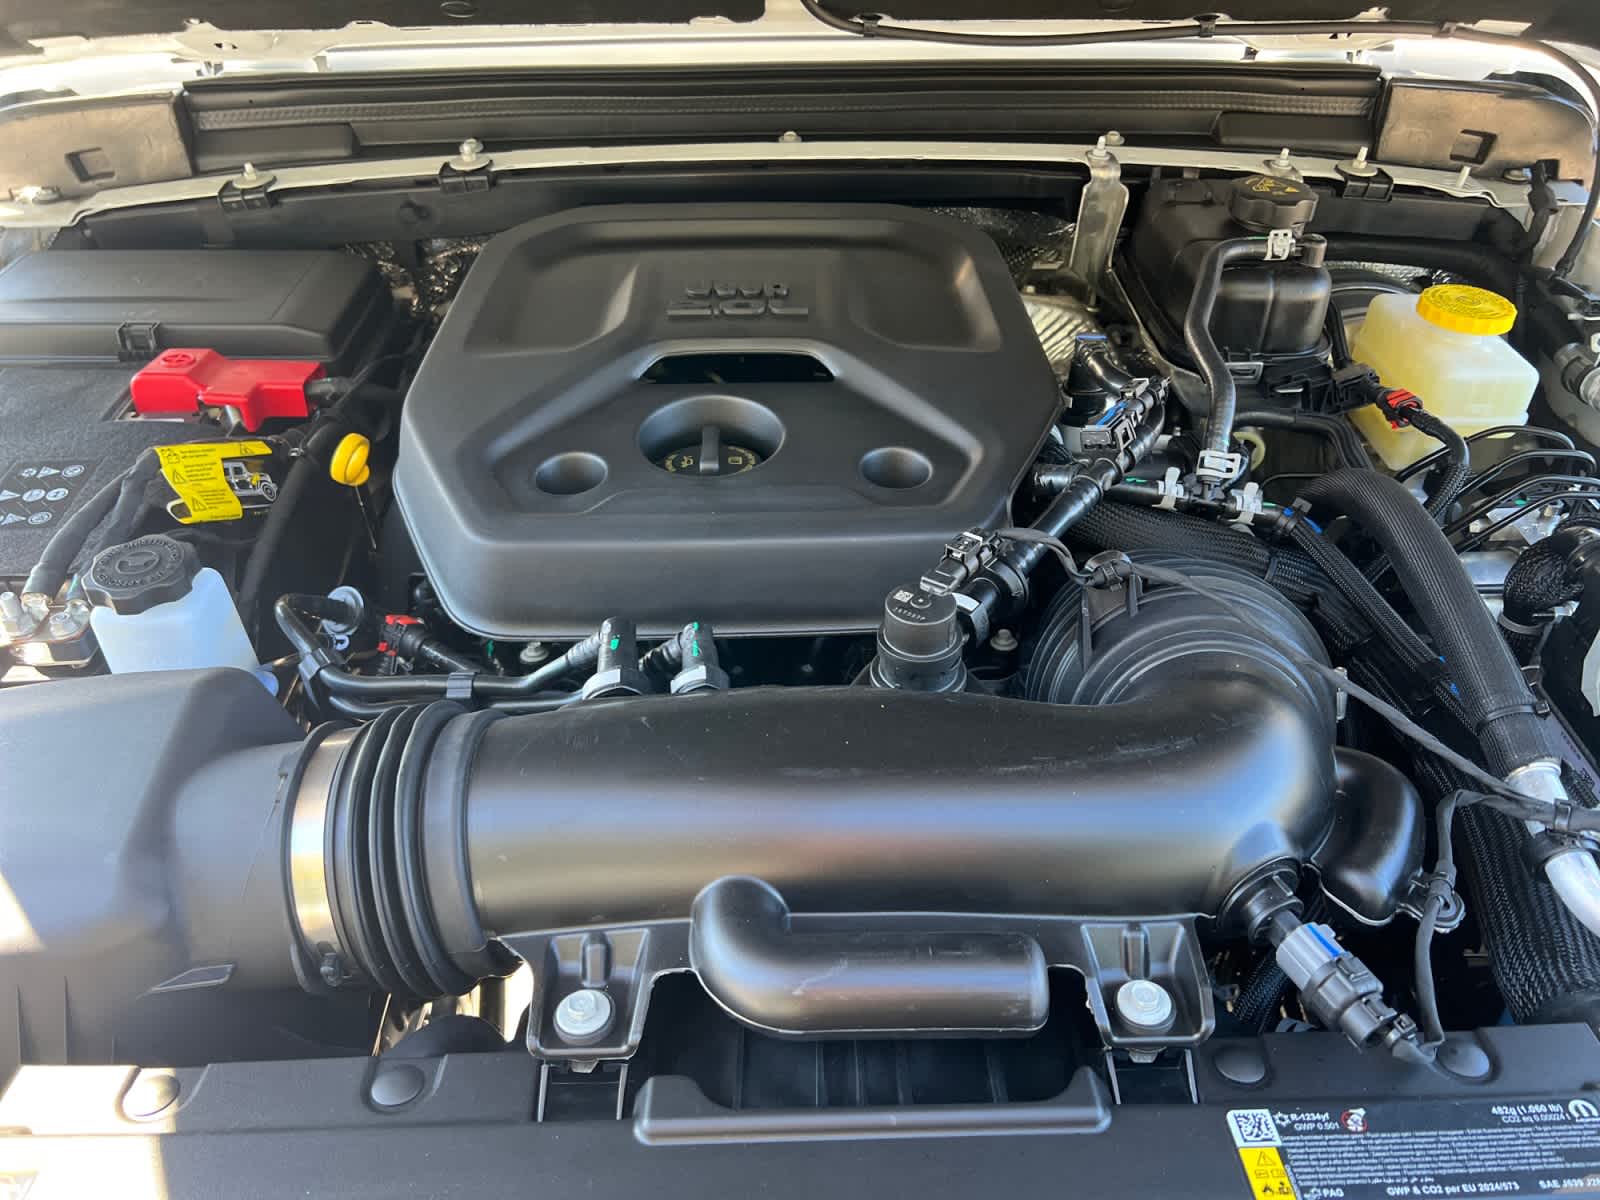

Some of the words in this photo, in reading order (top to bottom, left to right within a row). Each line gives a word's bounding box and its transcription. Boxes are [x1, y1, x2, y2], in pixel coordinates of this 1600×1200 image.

[1386, 1185, 1410, 1196] GWP
[1412, 1186, 1421, 1195] &
[1421, 1184, 1444, 1194] CO2
[1444, 1185, 1460, 1196] per
[1461, 1183, 1477, 1193] EU
[1478, 1181, 1520, 1192] 2024/573
[1538, 1179, 1561, 1190] SAE
[1322, 1188, 1344, 1197] PAG
